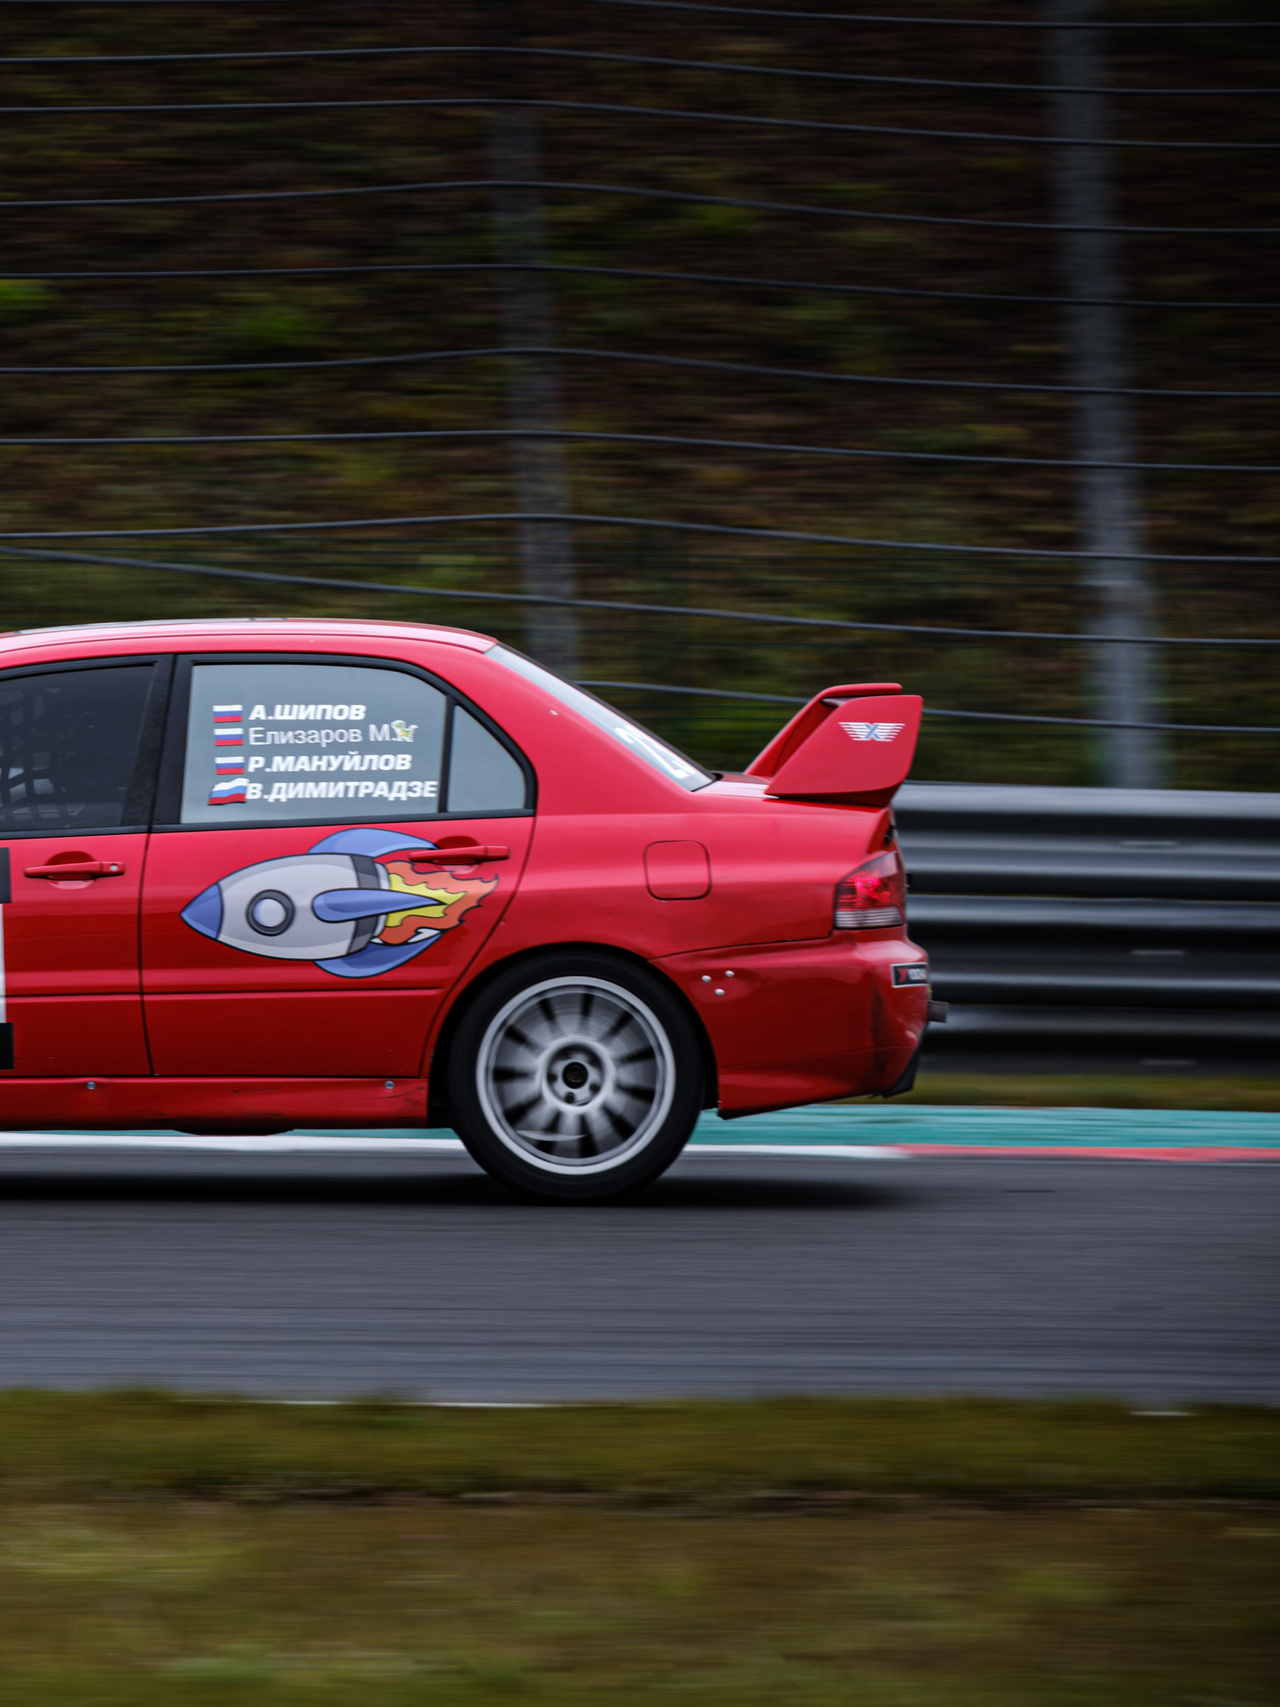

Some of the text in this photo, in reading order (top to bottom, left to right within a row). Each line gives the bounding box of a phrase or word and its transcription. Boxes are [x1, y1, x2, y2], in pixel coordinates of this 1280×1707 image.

[248, 704, 367, 720] А.ШИПОВ
[248, 727, 363, 747] Елизаров
[247, 751, 413, 772] Р.МАНУЙЛОВ
[244, 781, 439, 802] В.ДИМИТРАДЗЕ
